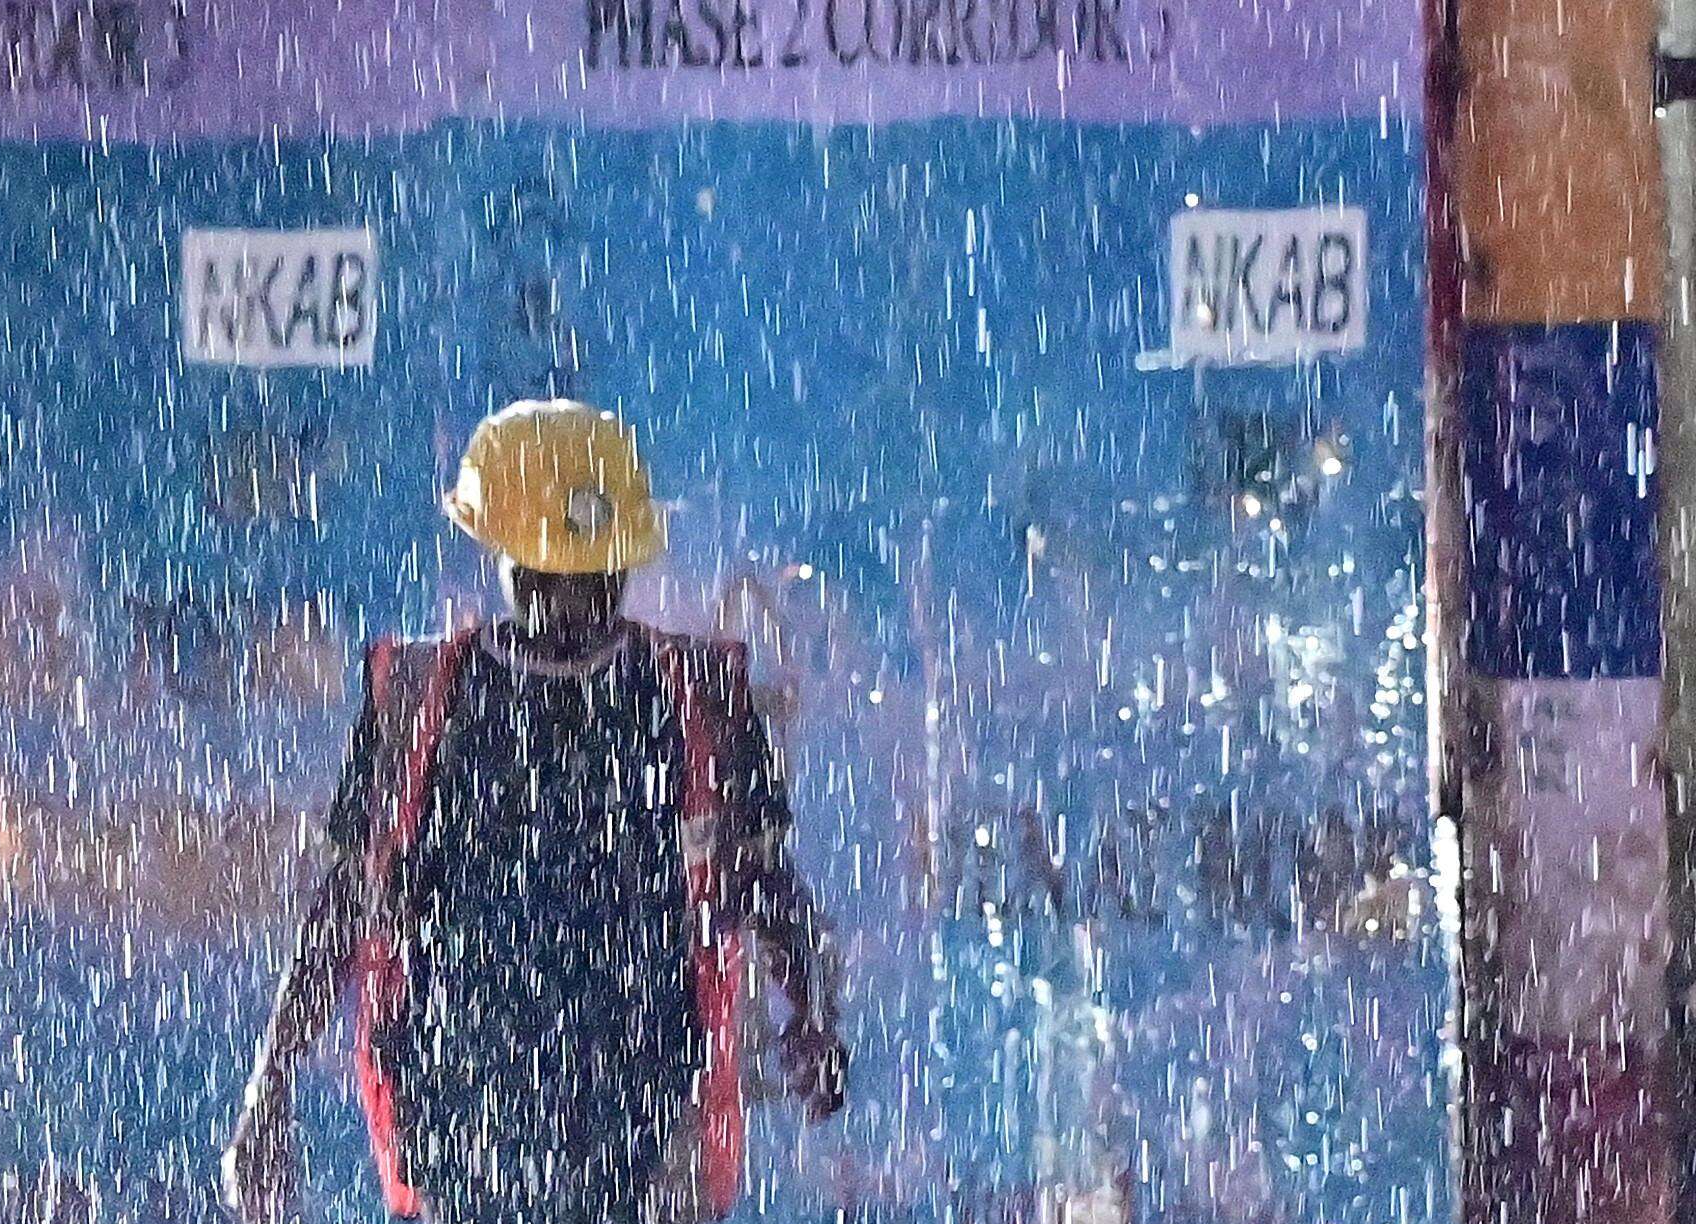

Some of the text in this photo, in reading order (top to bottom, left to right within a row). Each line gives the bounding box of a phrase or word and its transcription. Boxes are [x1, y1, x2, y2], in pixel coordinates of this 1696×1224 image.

[585, 0, 764, 68] PHASE
[779, 0, 810, 67] 2
[823, 0, 1130, 66] CORRIDOR
[198, 252, 366, 348] NKAB
[1180, 229, 1351, 336] NKAB
